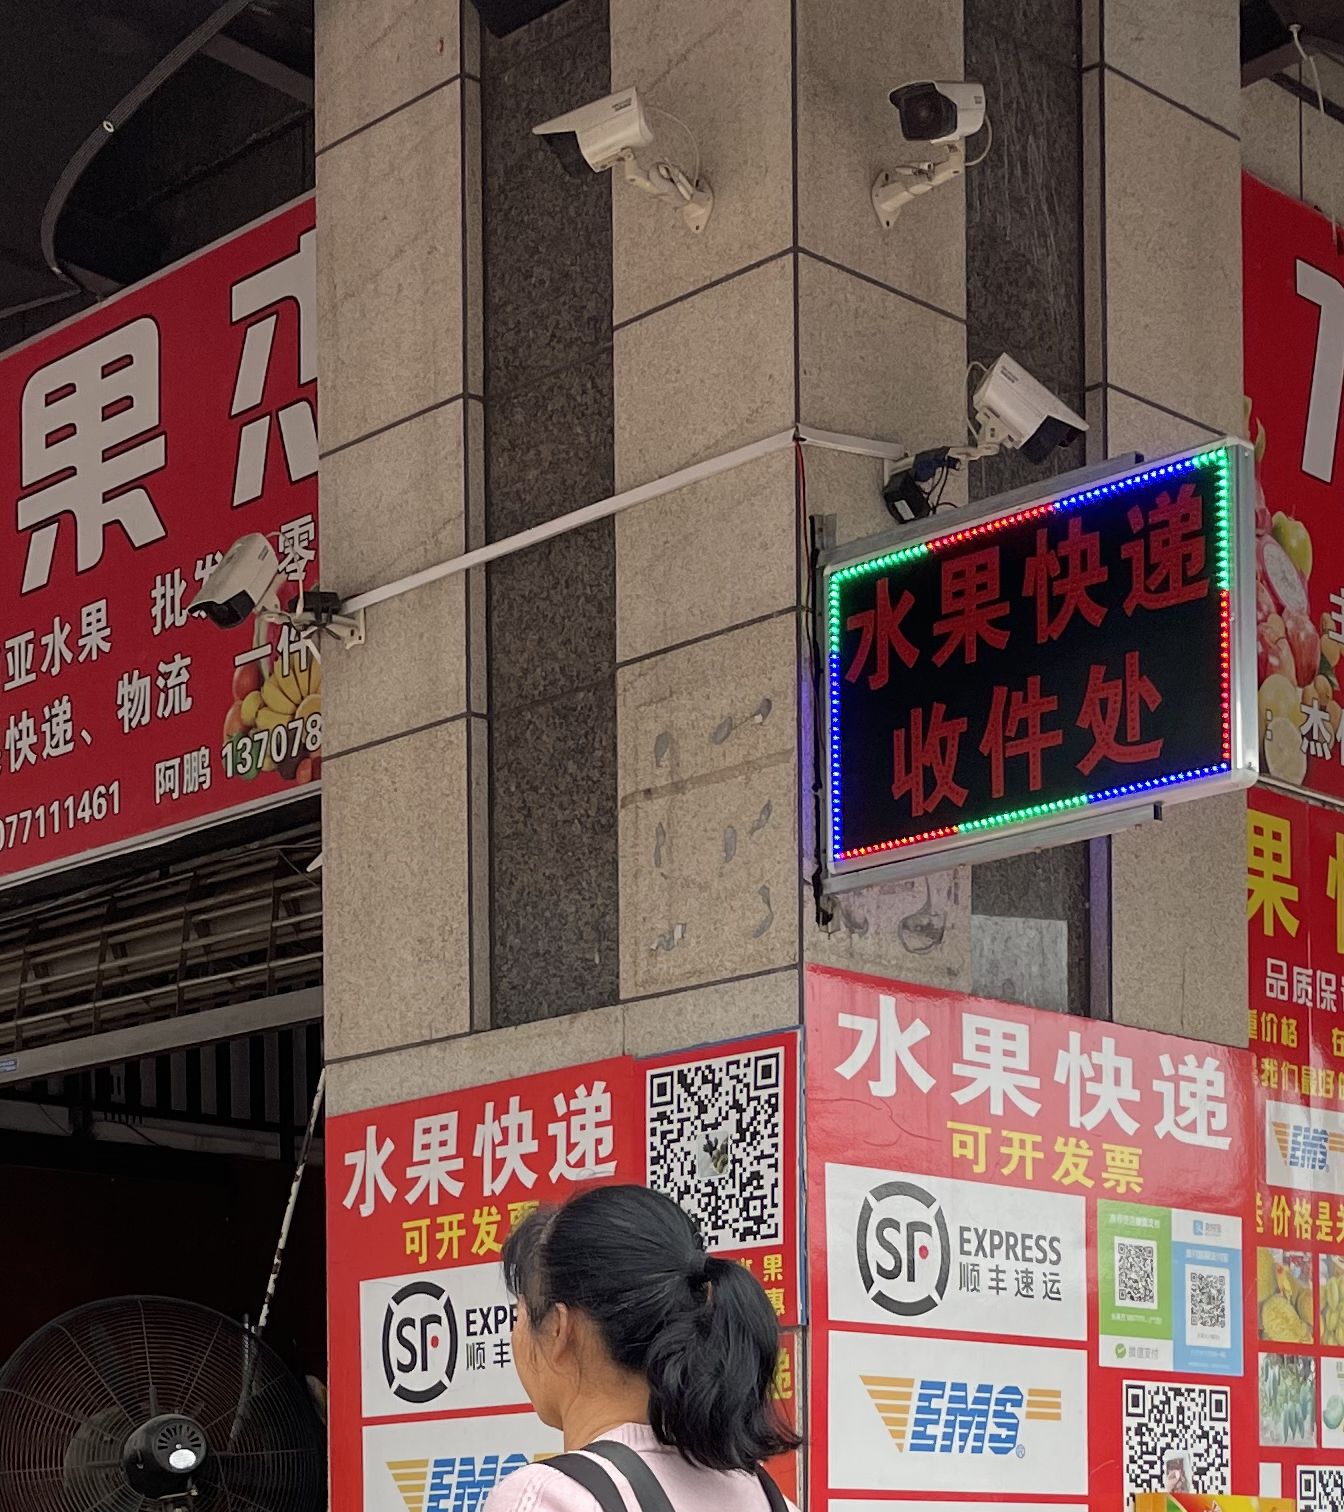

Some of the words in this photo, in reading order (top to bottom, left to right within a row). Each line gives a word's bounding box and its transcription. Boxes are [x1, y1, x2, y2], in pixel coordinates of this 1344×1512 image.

[844, 484, 1209, 691] 水果快递
[891, 650, 1165, 818] 收件处
[154, 750, 212, 805] 阿鹏
[835, 995, 1234, 1151] 水果快递
[342, 1080, 619, 1218] 水果快递
[946, 1120, 1145, 1195] 可开发票
[958, 1260, 1063, 1302] 顺丰速运
[959, 1224, 1063, 1267] EXPRESS
[908, 1379, 1025, 1456] EMS
